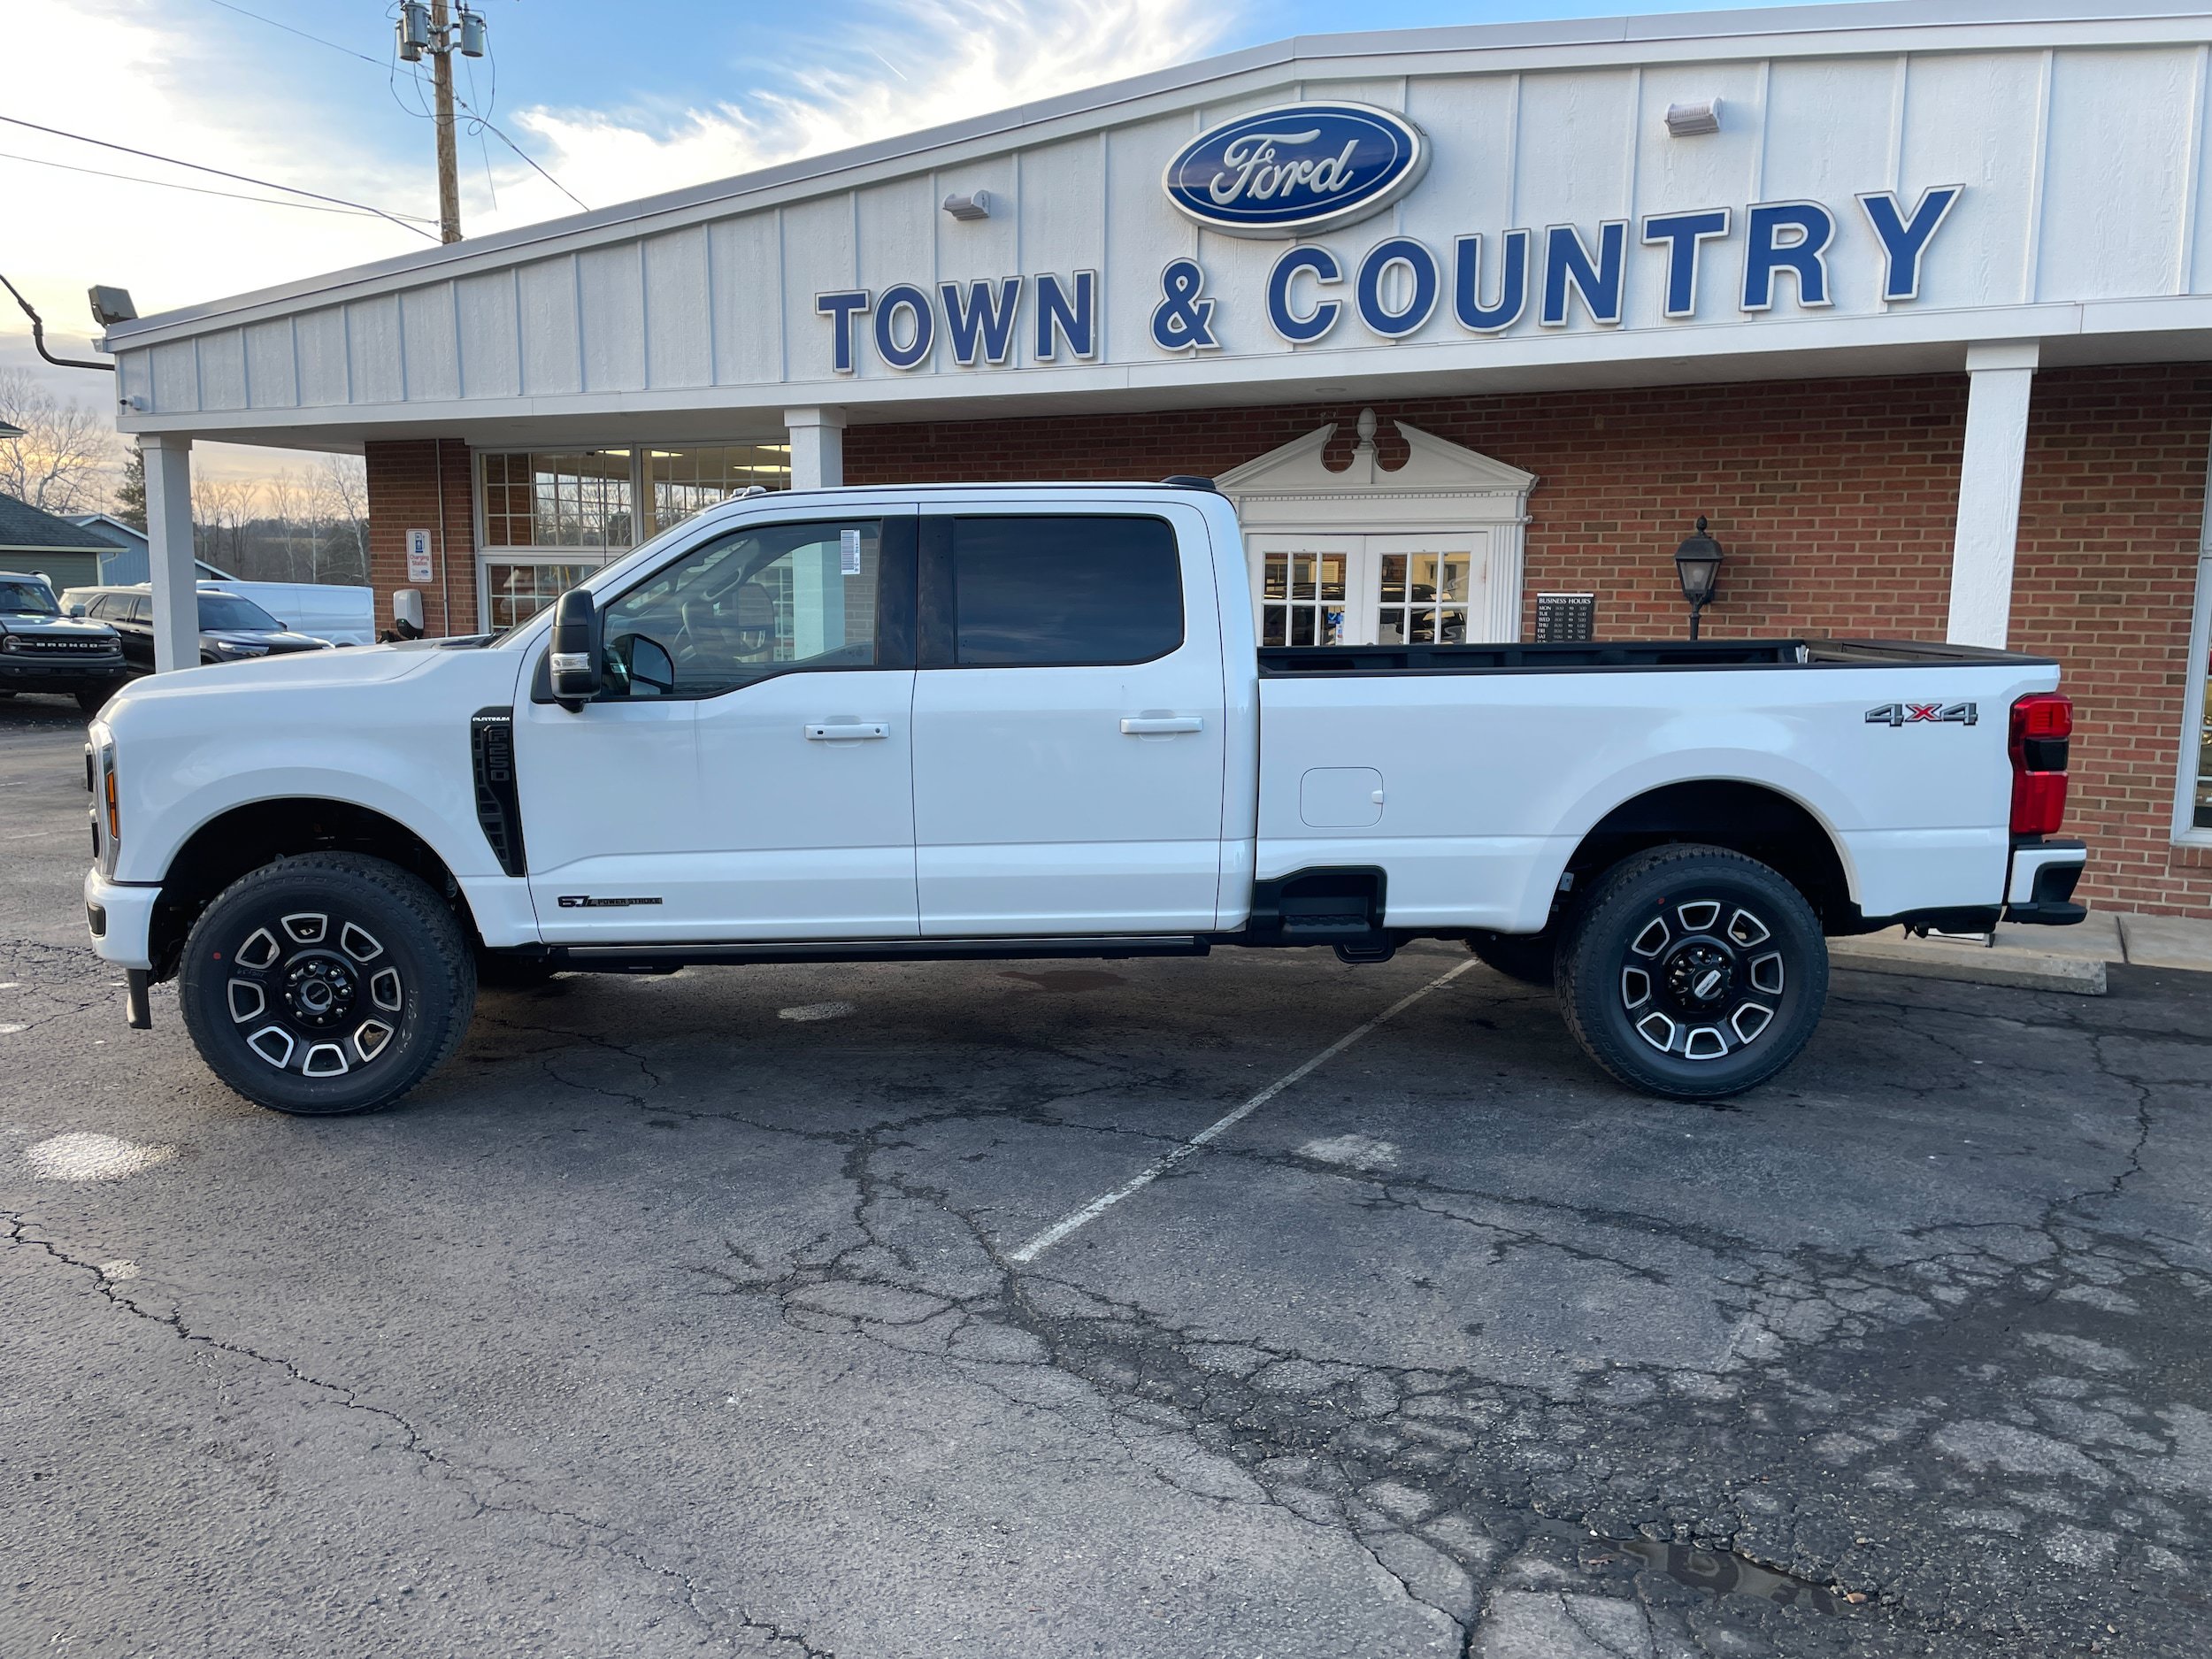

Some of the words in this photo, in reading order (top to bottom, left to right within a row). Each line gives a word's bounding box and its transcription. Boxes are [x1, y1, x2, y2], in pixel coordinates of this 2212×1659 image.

[1209, 128, 1358, 206] Ford
[815, 268, 1097, 374] TOWN
[1149, 256, 1222, 353] &
[1265, 183, 1966, 345] COUNTRY
